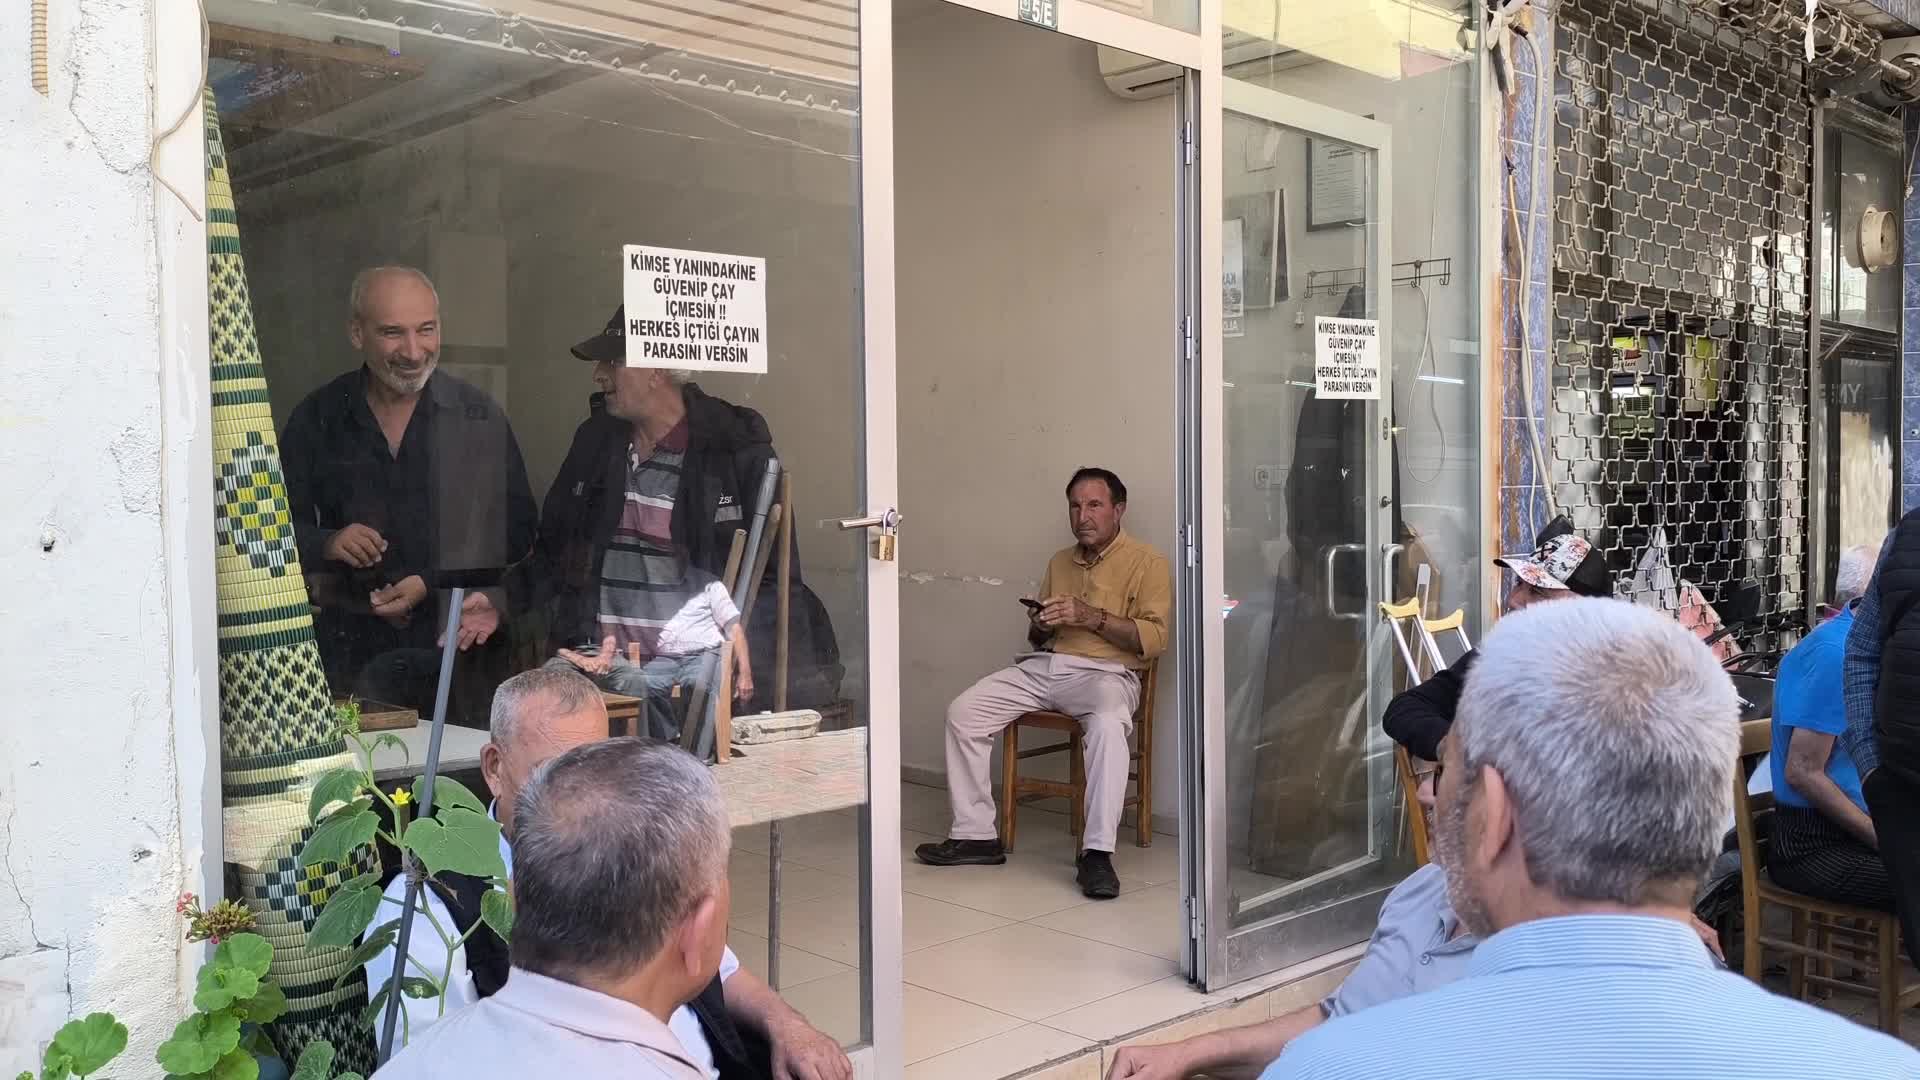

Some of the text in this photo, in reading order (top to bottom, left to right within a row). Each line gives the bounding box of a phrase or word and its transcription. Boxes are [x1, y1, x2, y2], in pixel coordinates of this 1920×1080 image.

[631, 251, 756, 281] KİMSE YANINDAKİNE
[653, 275, 736, 302] GÜVENİP ÇAY
[665, 296, 726, 320] İÇMESİN !!
[630, 319, 680, 338] HERKES
[684, 319, 720, 343] İÇTİĞİ
[724, 326, 760, 345] ÇAYIN
[1318, 320, 1336, 334] KİMSE
[643, 342, 748, 363] PARASINI VERSİN
[1328, 336, 1366, 352] GÜVENİP ÇAY
[1317, 366, 1341, 378] HERKES
[1352, 380, 1372, 393] VERSİN
